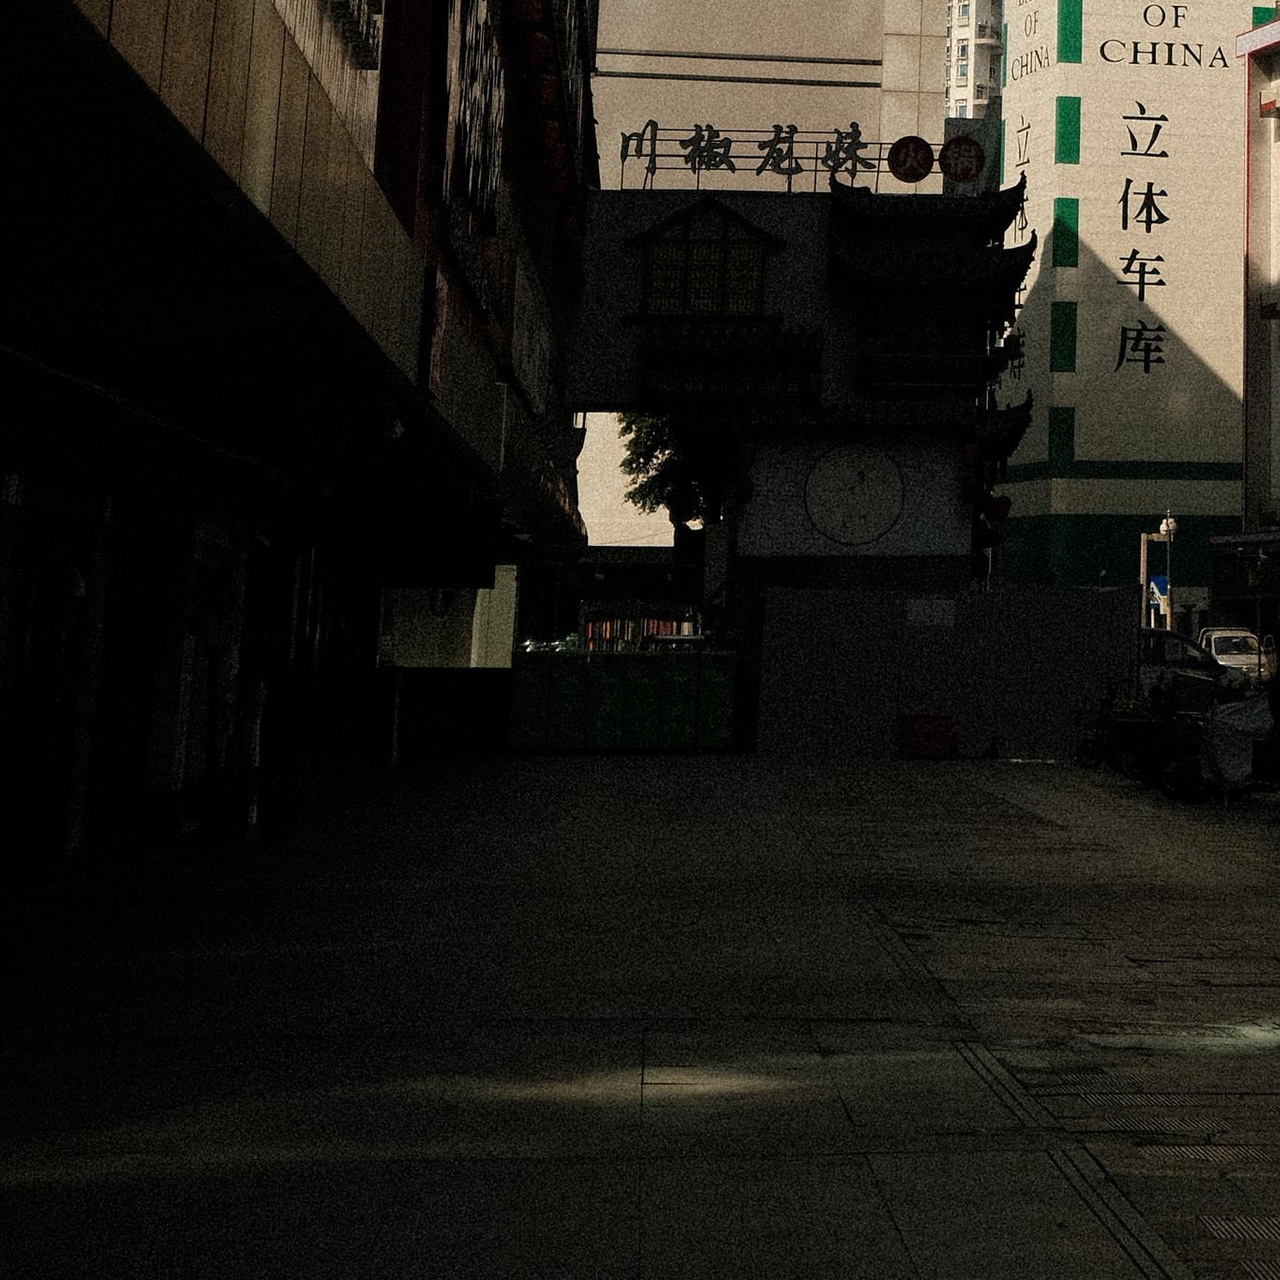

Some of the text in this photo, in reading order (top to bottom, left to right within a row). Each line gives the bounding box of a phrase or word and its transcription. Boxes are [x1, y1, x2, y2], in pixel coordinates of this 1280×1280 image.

[1023, 9, 1040, 38] OF
[1143, 2, 1190, 28] OF
[1011, 44, 1051, 82] CHINA
[1098, 38, 1231, 69] CHINA
[1114, 101, 1171, 375] 立体车库
